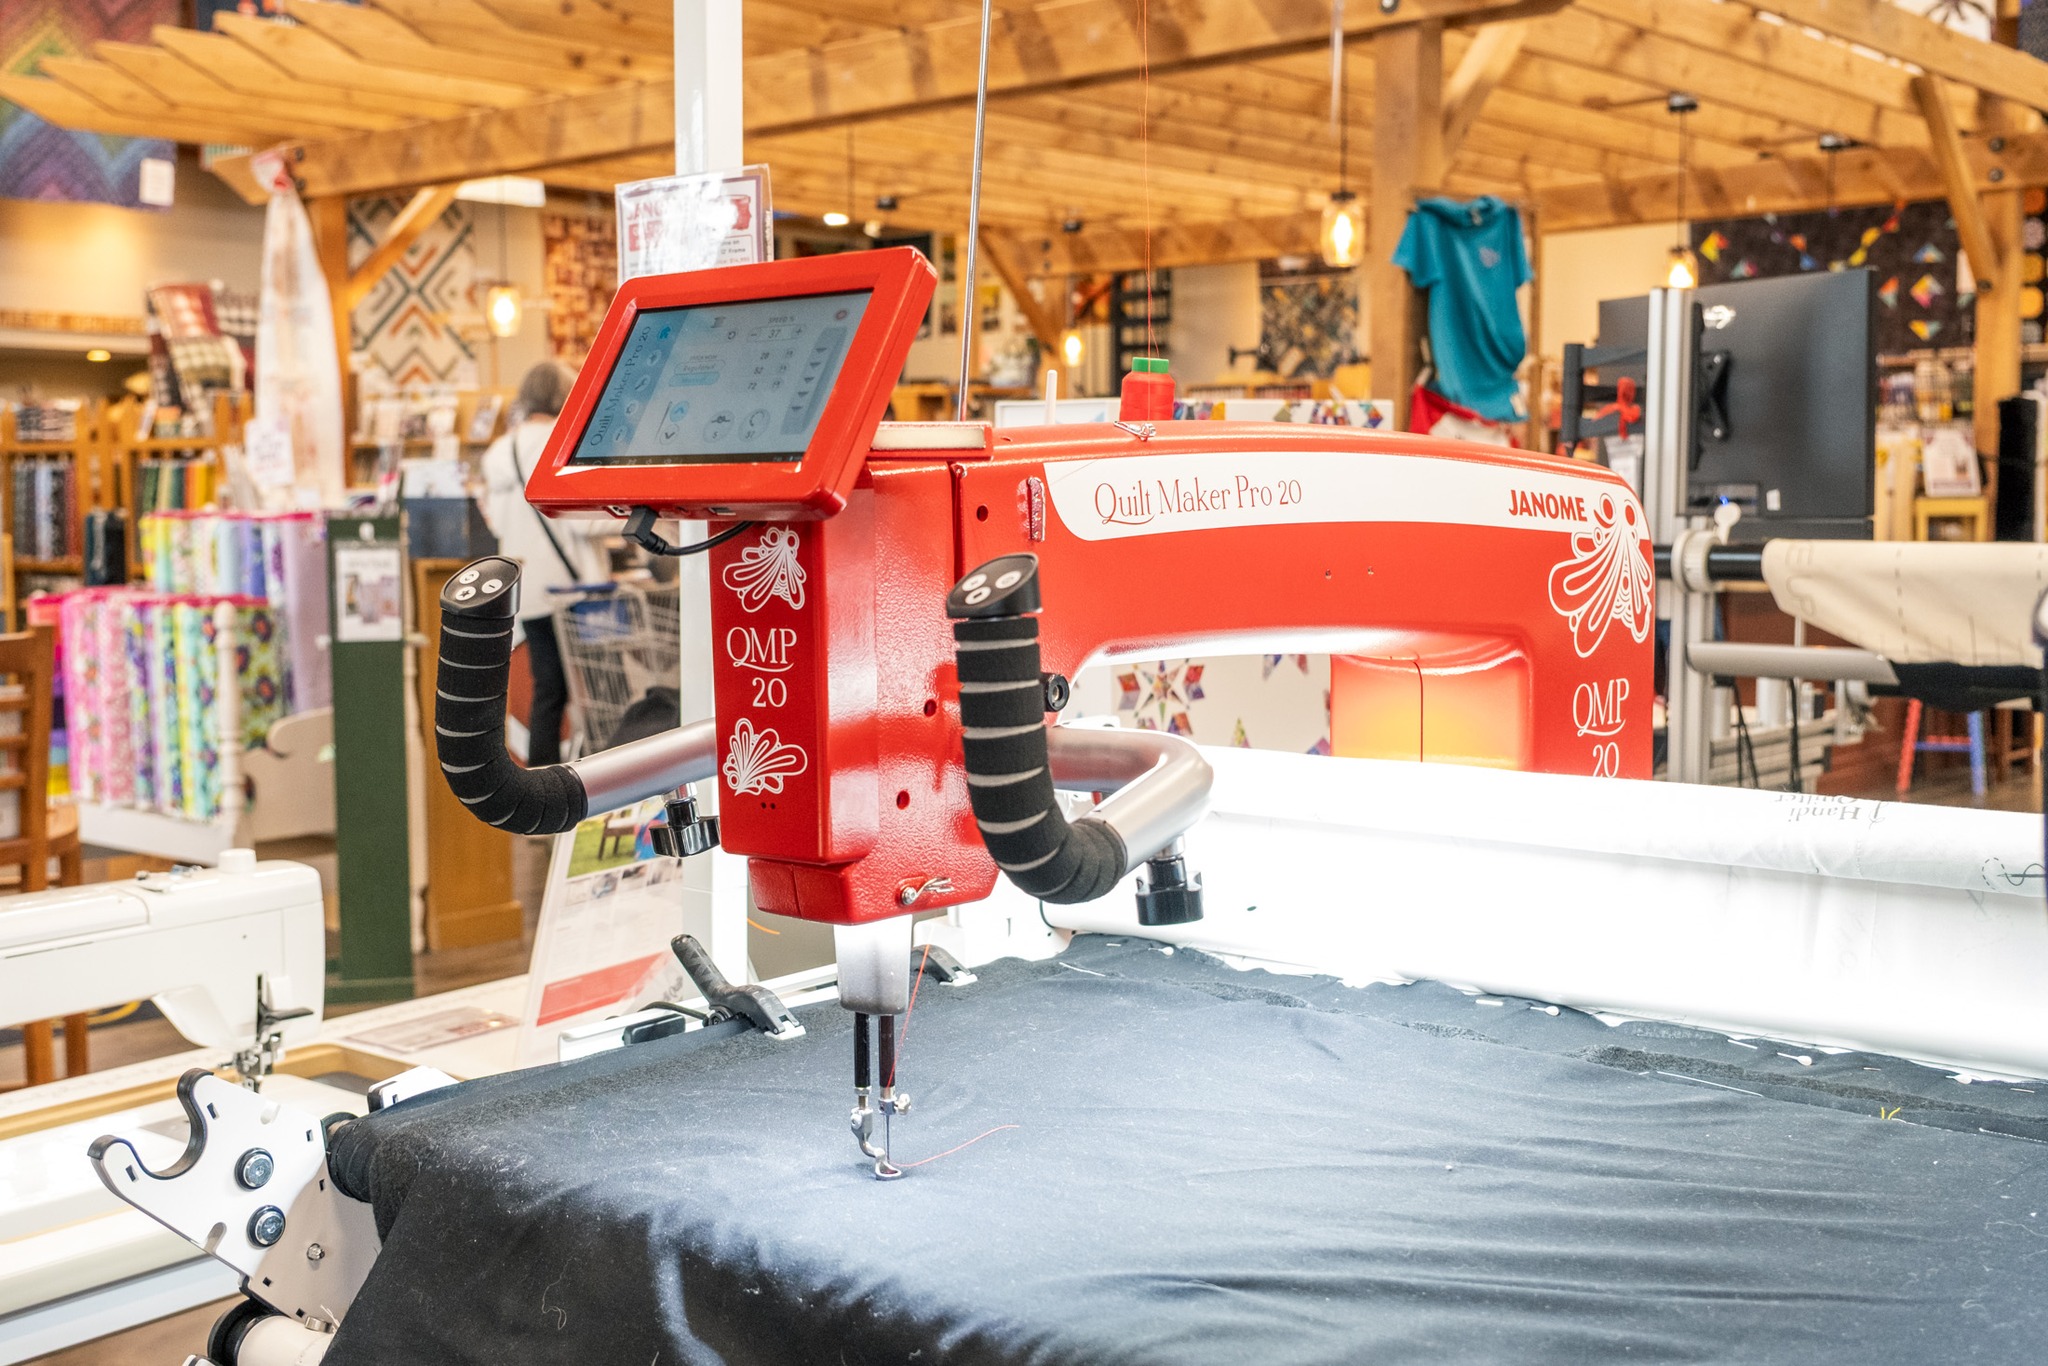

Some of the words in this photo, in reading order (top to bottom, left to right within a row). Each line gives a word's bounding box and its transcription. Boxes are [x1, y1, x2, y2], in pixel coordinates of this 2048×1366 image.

[768, 329, 781, 339] 37
[590, 412, 615, 446] Quilt
[605, 371, 632, 411] Maker
[625, 345, 643, 367] Pro
[641, 326, 651, 342] 20
[1094, 480, 1155, 525] Quilt
[1157, 476, 1231, 514] Maker
[1235, 475, 1272, 508] Pro
[1278, 479, 1302, 505] 20
[1508, 489, 1588, 522] JANOME
[726, 626, 797, 673] QMP
[752, 677, 787, 708] 20
[1572, 677, 1630, 737] QMP
[1592, 742, 1620, 778] 20
[1788, 805, 1861, 822] Handi
